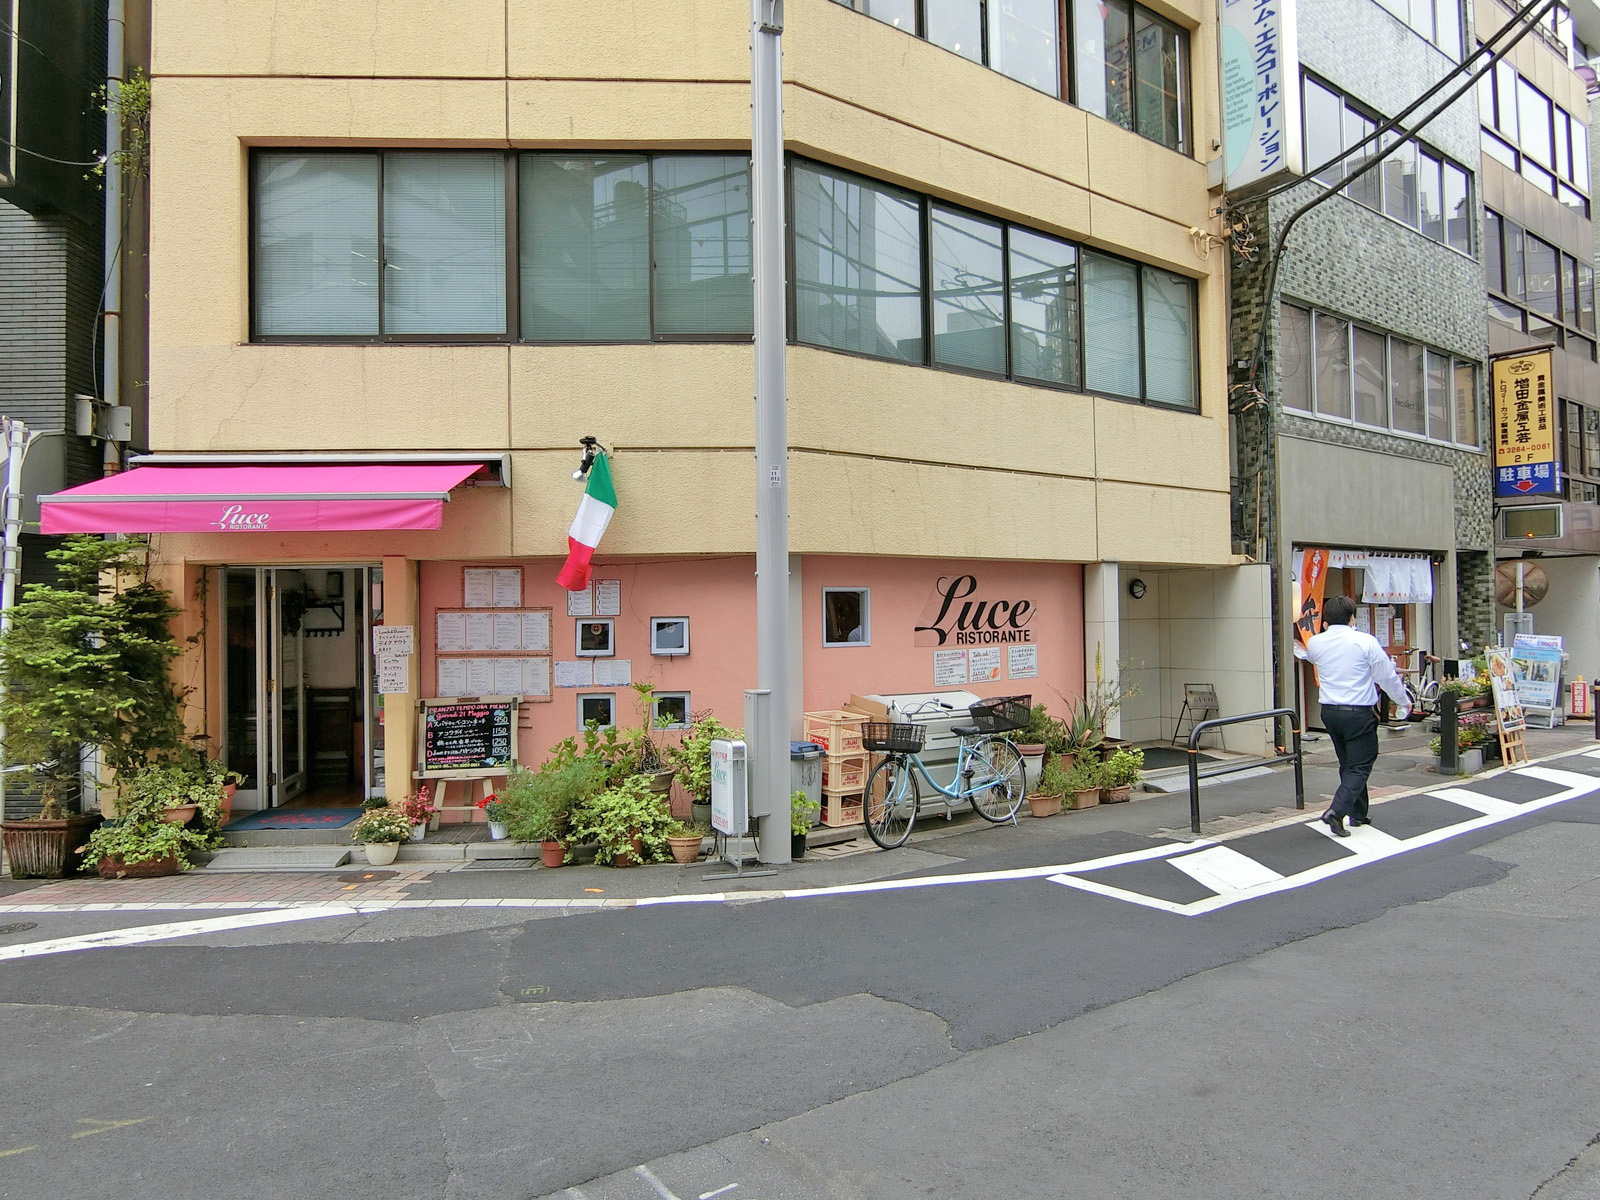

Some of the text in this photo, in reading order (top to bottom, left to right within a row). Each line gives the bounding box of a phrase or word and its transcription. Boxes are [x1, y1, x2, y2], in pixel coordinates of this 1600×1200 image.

[1499, 464, 1550, 482] 駐車場
[210, 504, 272, 530] Luce
[914, 575, 1036, 645] Luce
[957, 629, 1031, 644] RISTORANTE
[467, 710, 490, 718] Maggio
[427, 731, 433, 739] B
[492, 727, 507, 735] 1150
[492, 738, 507, 746] 1250
